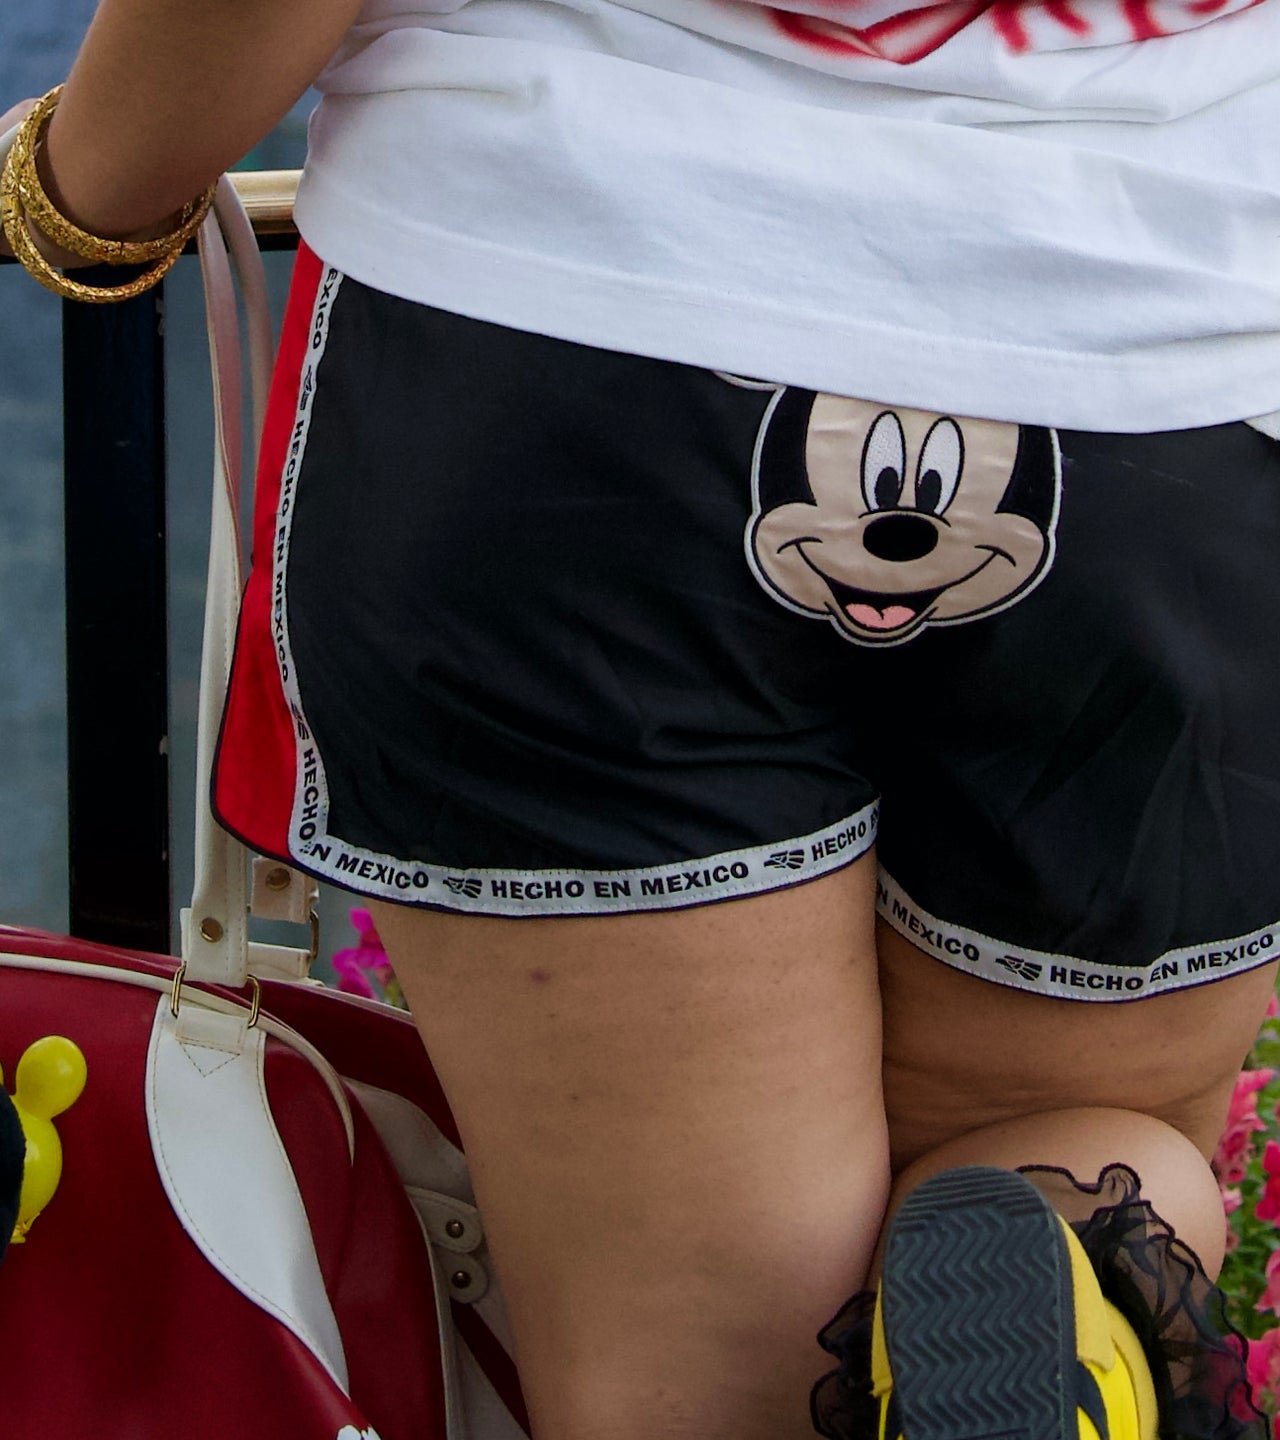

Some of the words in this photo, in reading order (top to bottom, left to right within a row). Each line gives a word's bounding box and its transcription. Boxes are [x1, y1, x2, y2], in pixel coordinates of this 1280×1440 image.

[313, 268, 338, 350] EXICO
[282, 420, 305, 518] HECHO
[277, 525, 287, 564] EN
[274, 571, 289, 683] MEXICO
[298, 747, 319, 842] HECHO
[335, 852, 429, 889] MEXICO
[811, 820, 867, 862] HECHO
[491, 879, 585, 901] HECHO
[593, 879, 632, 899] EN
[640, 861, 749, 896] MEXICO
[892, 898, 980, 962] MEXICO
[1050, 964, 1144, 991] HECHO
[1148, 961, 1179, 984] EN
[1187, 933, 1274, 974] MEXICO
